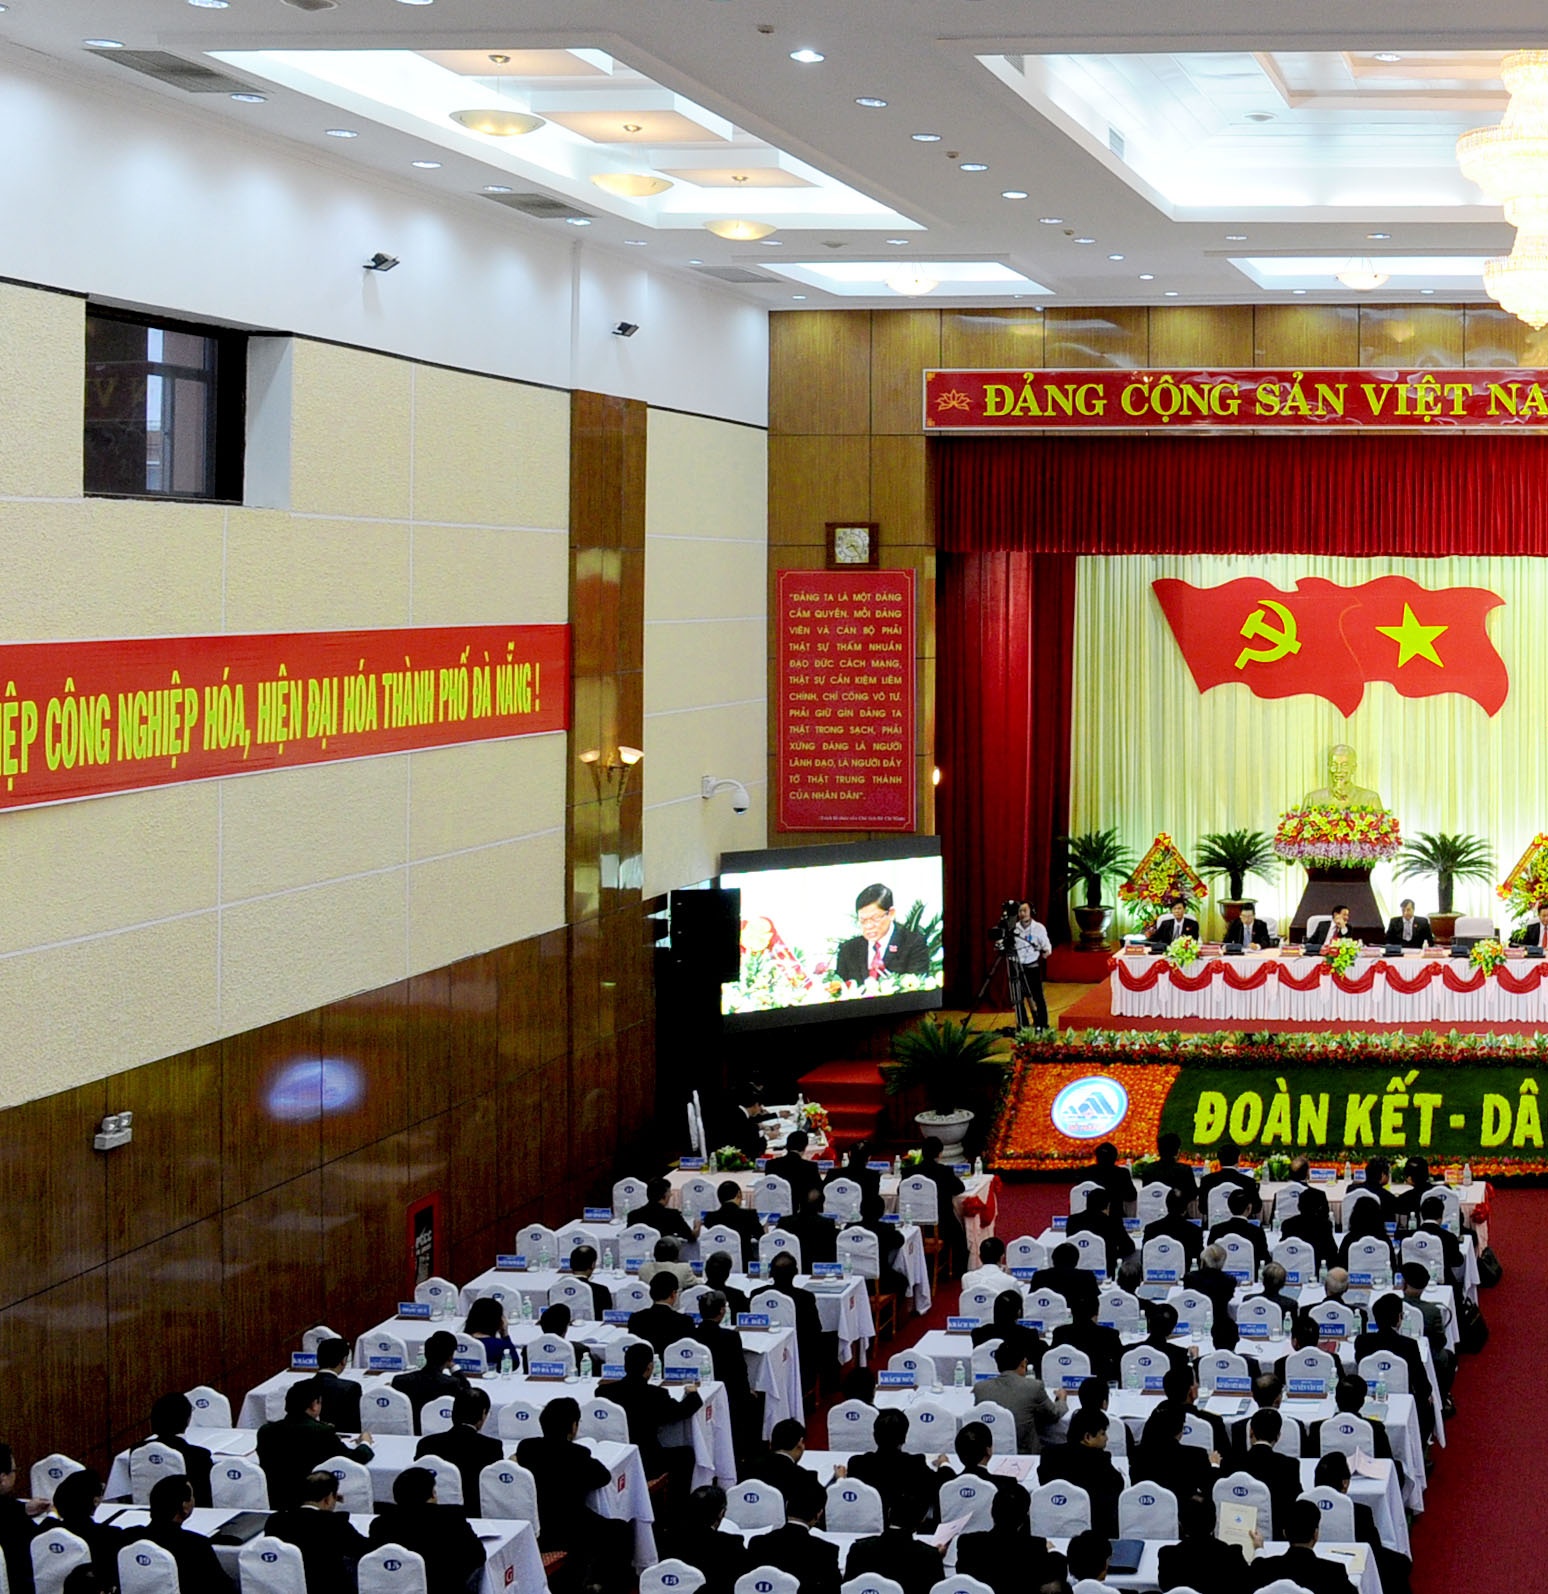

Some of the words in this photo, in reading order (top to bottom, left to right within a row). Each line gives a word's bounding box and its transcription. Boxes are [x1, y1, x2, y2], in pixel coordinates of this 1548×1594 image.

[983, 372, 1107, 417] ĐẢNG
[1121, 375, 1242, 423] CỘNG
[1256, 371, 1348, 417] SẢN
[1361, 375, 1474, 423] VIỆT
[0, 681, 39, 791] ỆP
[45, 677, 112, 771] CÔNG
[117, 670, 199, 769] NGHIỆP
[203, 667, 252, 759] HÓA,
[257, 663, 302, 755] HIỆN
[307, 677, 338, 750] ĐẠI
[343, 658, 378, 735] HÓA
[382, 656, 435, 730] THÀNH
[439, 645, 470, 722] PHỐ
[473, 651, 492, 719] ĐÀ
[496, 641, 532, 716] NẴNG
[534, 662, 540, 712] !
[1193, 1077, 1330, 1148] ĐOÀN
[1343, 1071, 1442, 1148] KẾT
[1449, 1113, 1465, 1129] -
